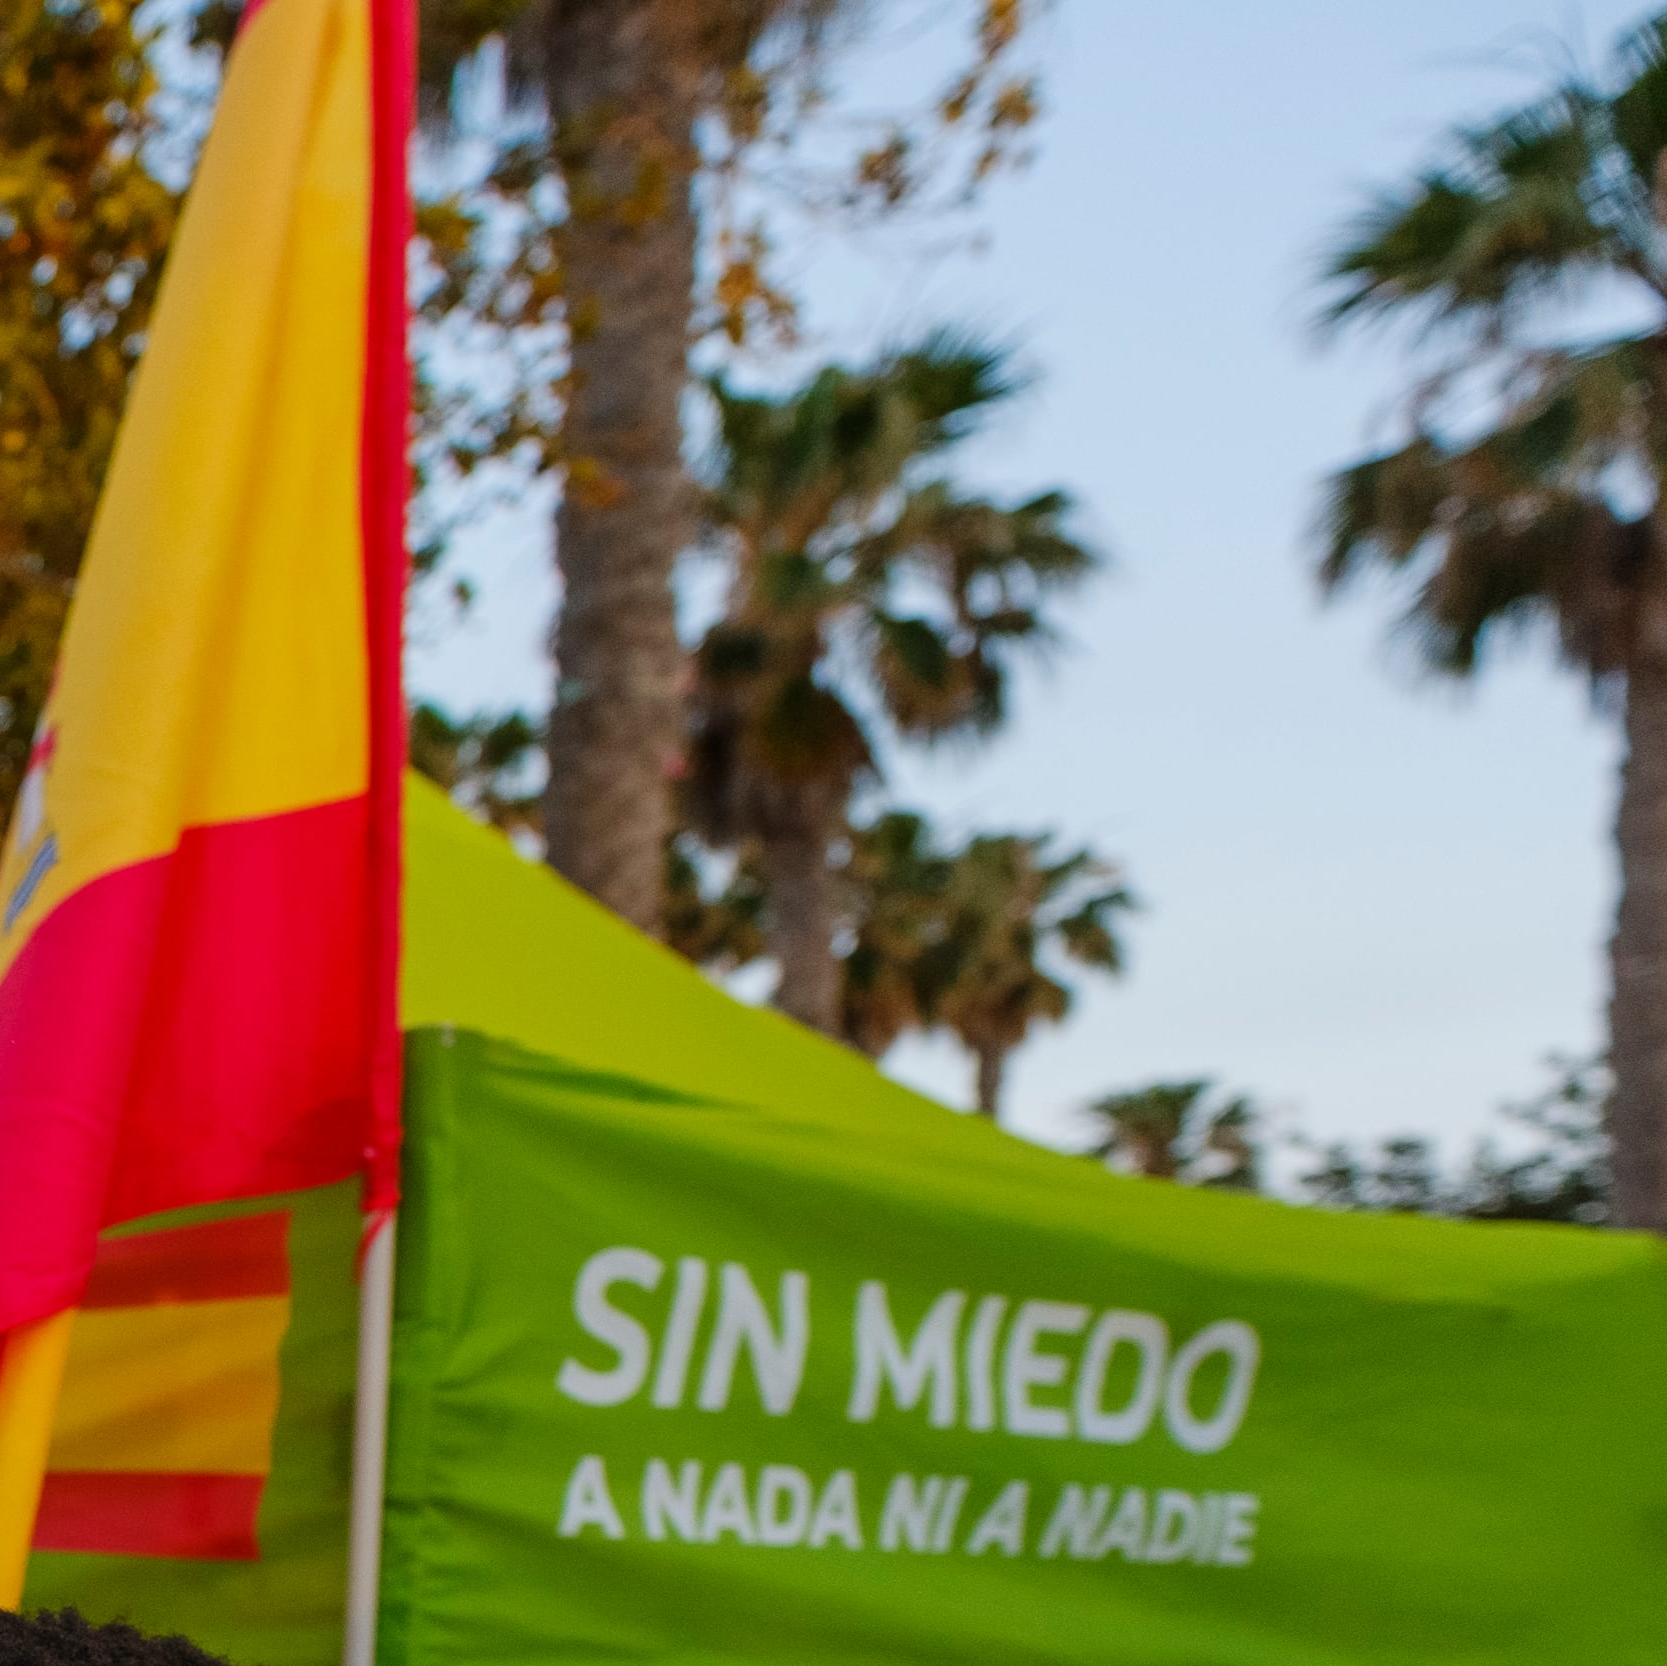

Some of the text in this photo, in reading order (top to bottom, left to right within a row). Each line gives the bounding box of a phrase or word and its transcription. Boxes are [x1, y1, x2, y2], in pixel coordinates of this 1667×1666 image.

[557, 1247, 1259, 1454] SIN MIEDO
[558, 1455, 1259, 1566] A NADA NI A NADIE
